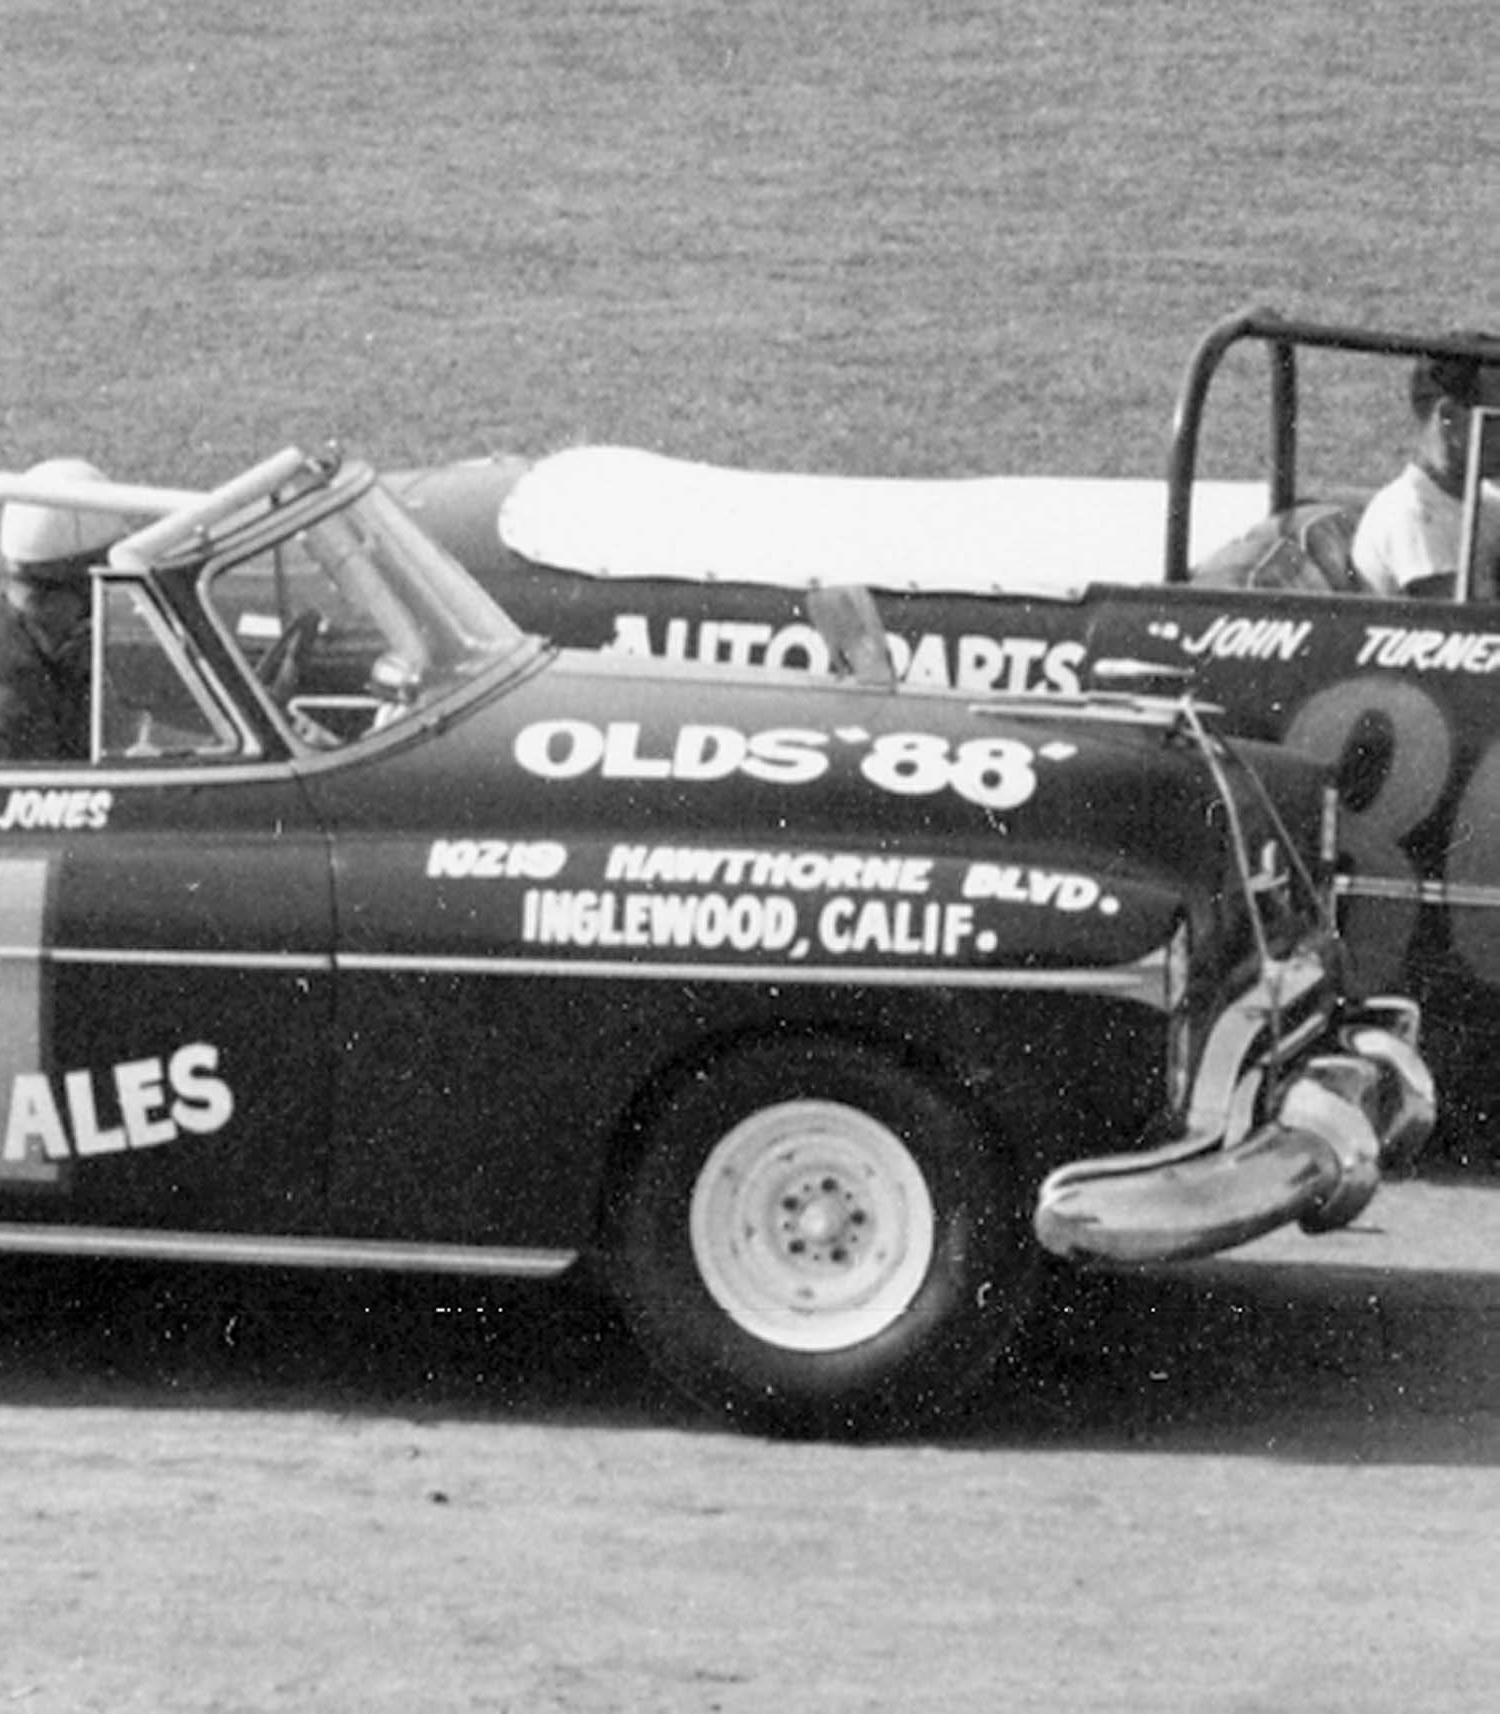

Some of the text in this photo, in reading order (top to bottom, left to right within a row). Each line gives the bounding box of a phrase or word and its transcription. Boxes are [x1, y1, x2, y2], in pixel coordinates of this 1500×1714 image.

[514, 719, 829, 782] OLDS
[604, 844, 934, 894] HAWTHORNE
[962, 863, 1120, 914] BLVD.
[521, 889, 998, 958] INGLEWOOD, CALIF.
